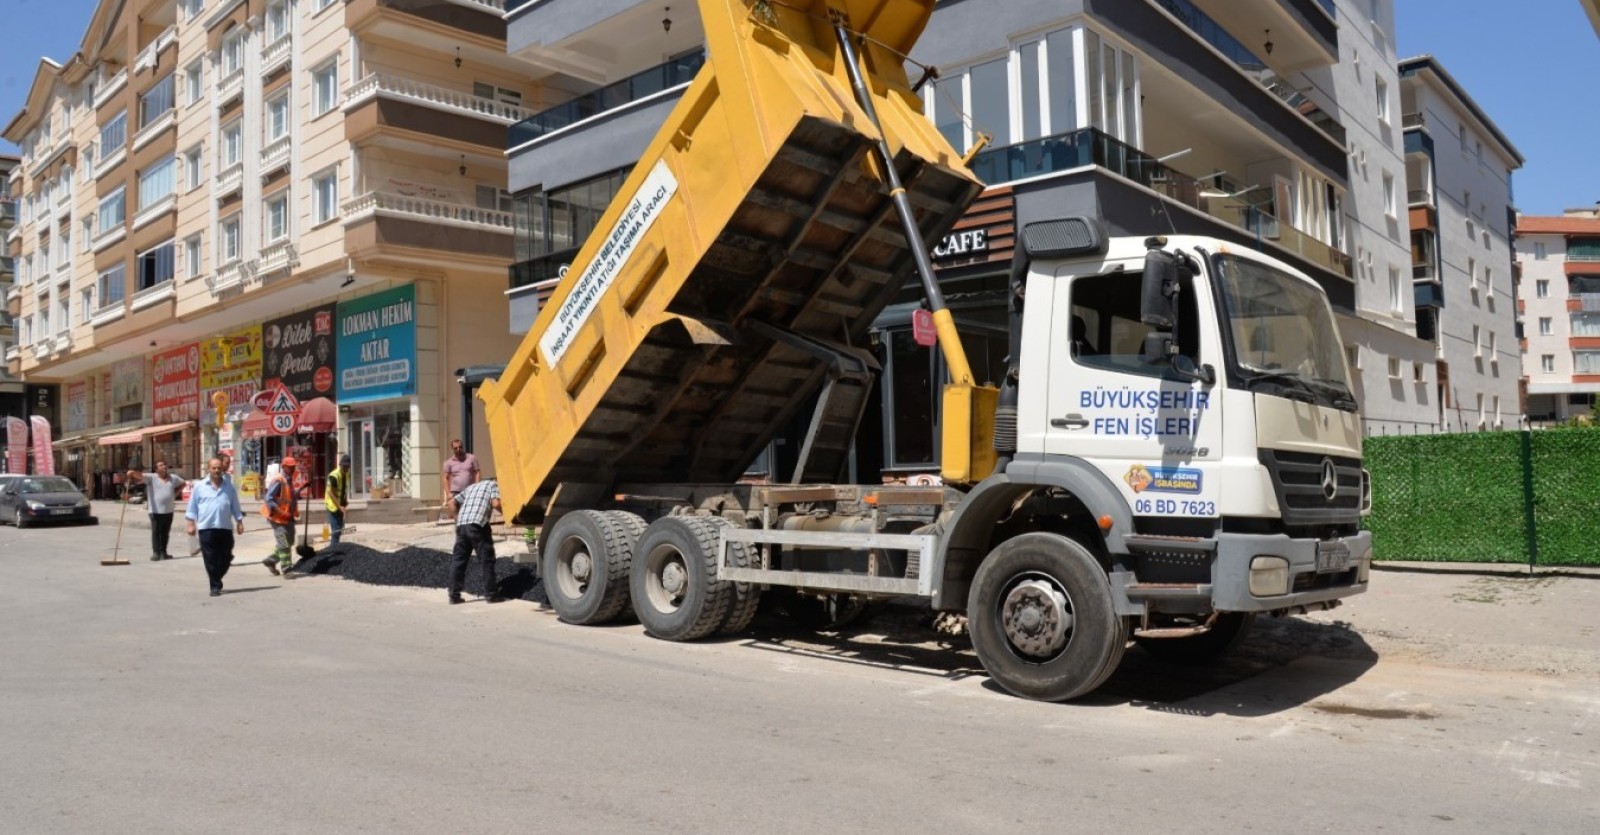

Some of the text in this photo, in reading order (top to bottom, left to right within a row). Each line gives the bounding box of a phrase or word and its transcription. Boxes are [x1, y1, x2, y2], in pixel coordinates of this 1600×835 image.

[934, 229, 985, 256] CAFE
[550, 185, 667, 356] İNŞAAT YIKINTI ATIĞI TAŞIMA ARACI
[559, 197, 642, 324] BÜYÜKŞEHİR BELEDİYESİ
[343, 298, 412, 336] LOKMAN HEKİM
[281, 320, 312, 348] Dilek
[280, 349, 314, 377] Perde
[361, 338, 389, 362] AKTAR
[1080, 386, 1210, 414] BÜYÜKŞEHİR
[277, 415, 291, 428] 30
[1094, 414, 1197, 440] FEN İŞLERİ
[1135, 500, 1215, 515] 06 BD 7623
